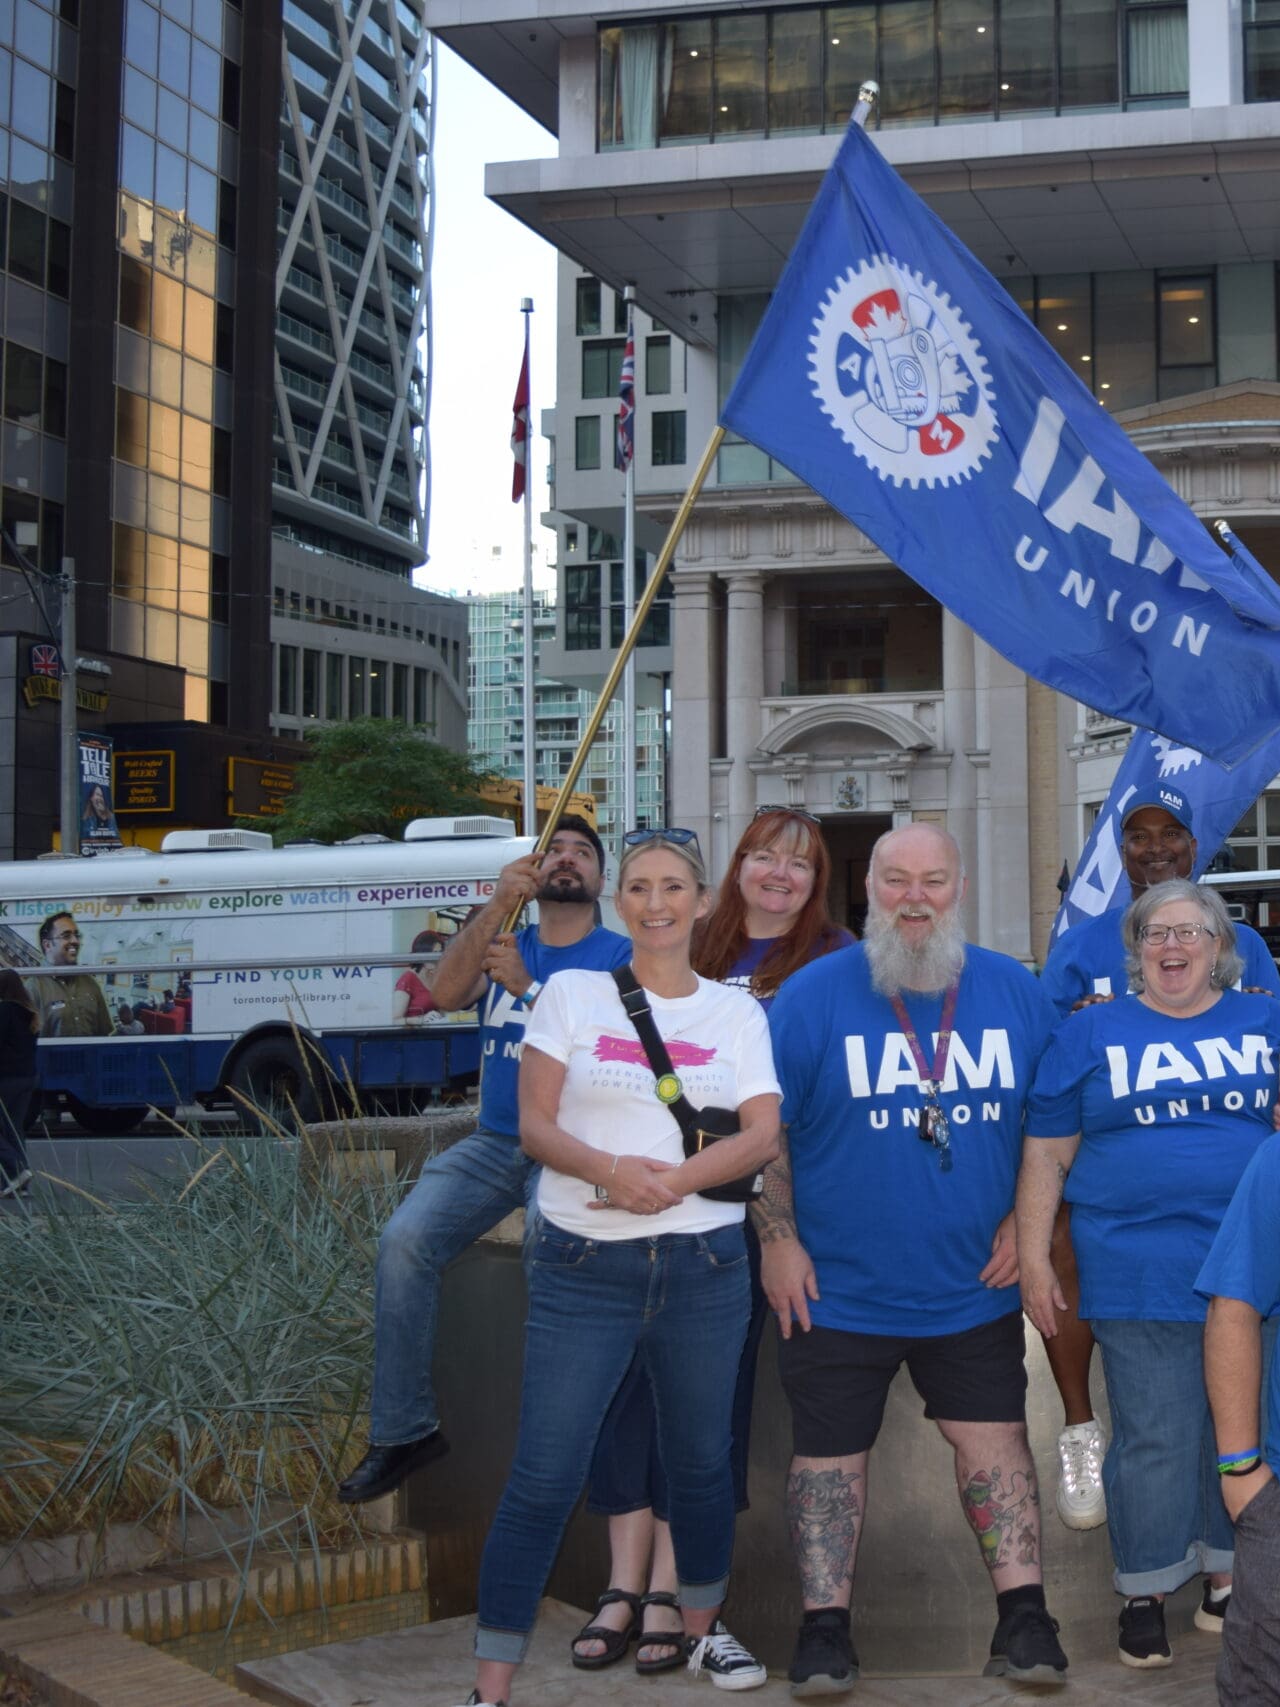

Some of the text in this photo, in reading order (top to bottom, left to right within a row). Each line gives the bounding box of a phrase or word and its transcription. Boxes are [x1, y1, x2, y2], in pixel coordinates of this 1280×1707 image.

[1015, 534, 1211, 657] UNION
[80, 746, 110, 764] TELL
[1160, 790, 1183, 807] IAM
[15, 899, 67, 916] listen
[72, 899, 123, 917] enjoy
[209, 890, 283, 912] explore
[290, 886, 350, 906] watch
[357, 882, 469, 905] experience
[214, 966, 375, 984] FIND YOUR WAY
[233, 992, 352, 1005] torontopubliclibrary.ca
[845, 1028, 1015, 1098] IAM
[1105, 1034, 1275, 1100] IAM
[869, 1102, 1001, 1130] UNON
[1134, 1088, 1269, 1125] UNION
